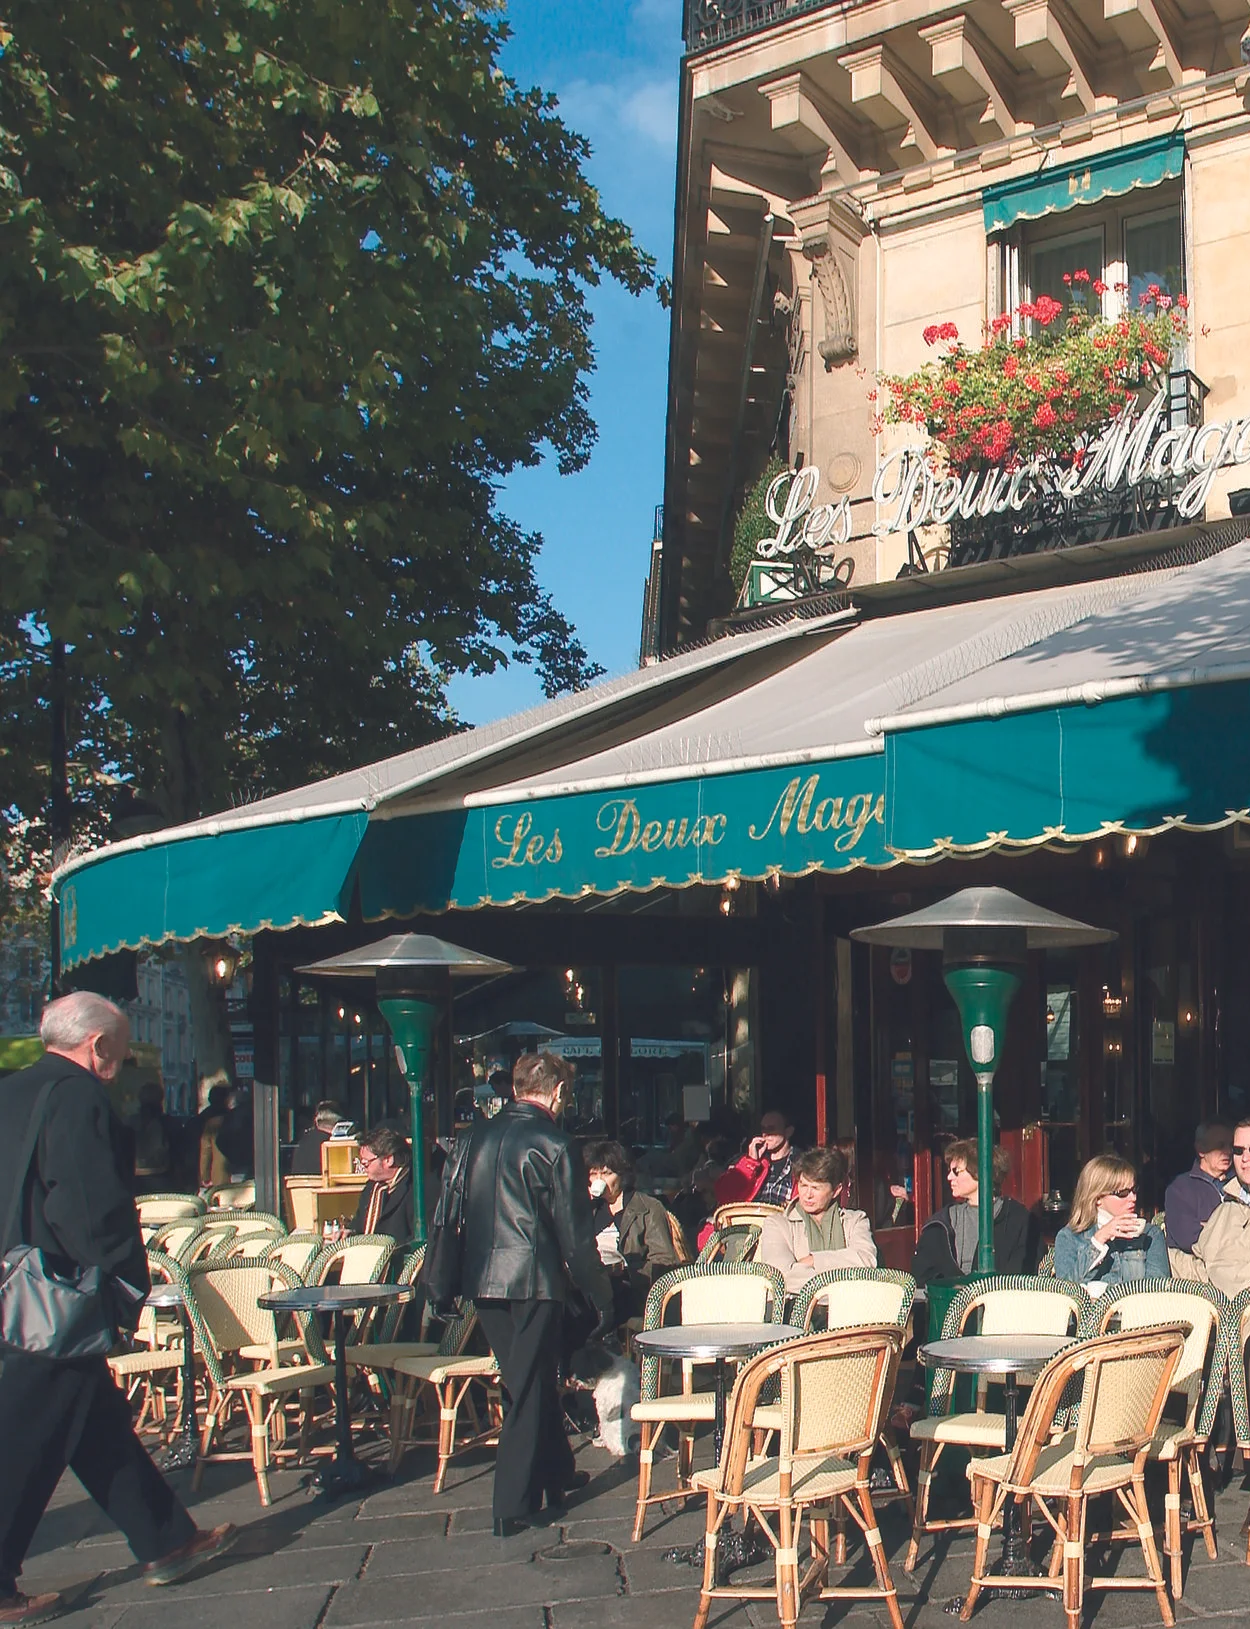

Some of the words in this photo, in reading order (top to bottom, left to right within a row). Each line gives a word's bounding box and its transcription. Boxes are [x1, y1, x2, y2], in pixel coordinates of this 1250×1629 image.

[757, 465, 852, 557] Les
[872, 444, 1037, 537] Deux
[491, 811, 564, 869] Les
[595, 798, 727, 858] Deux
